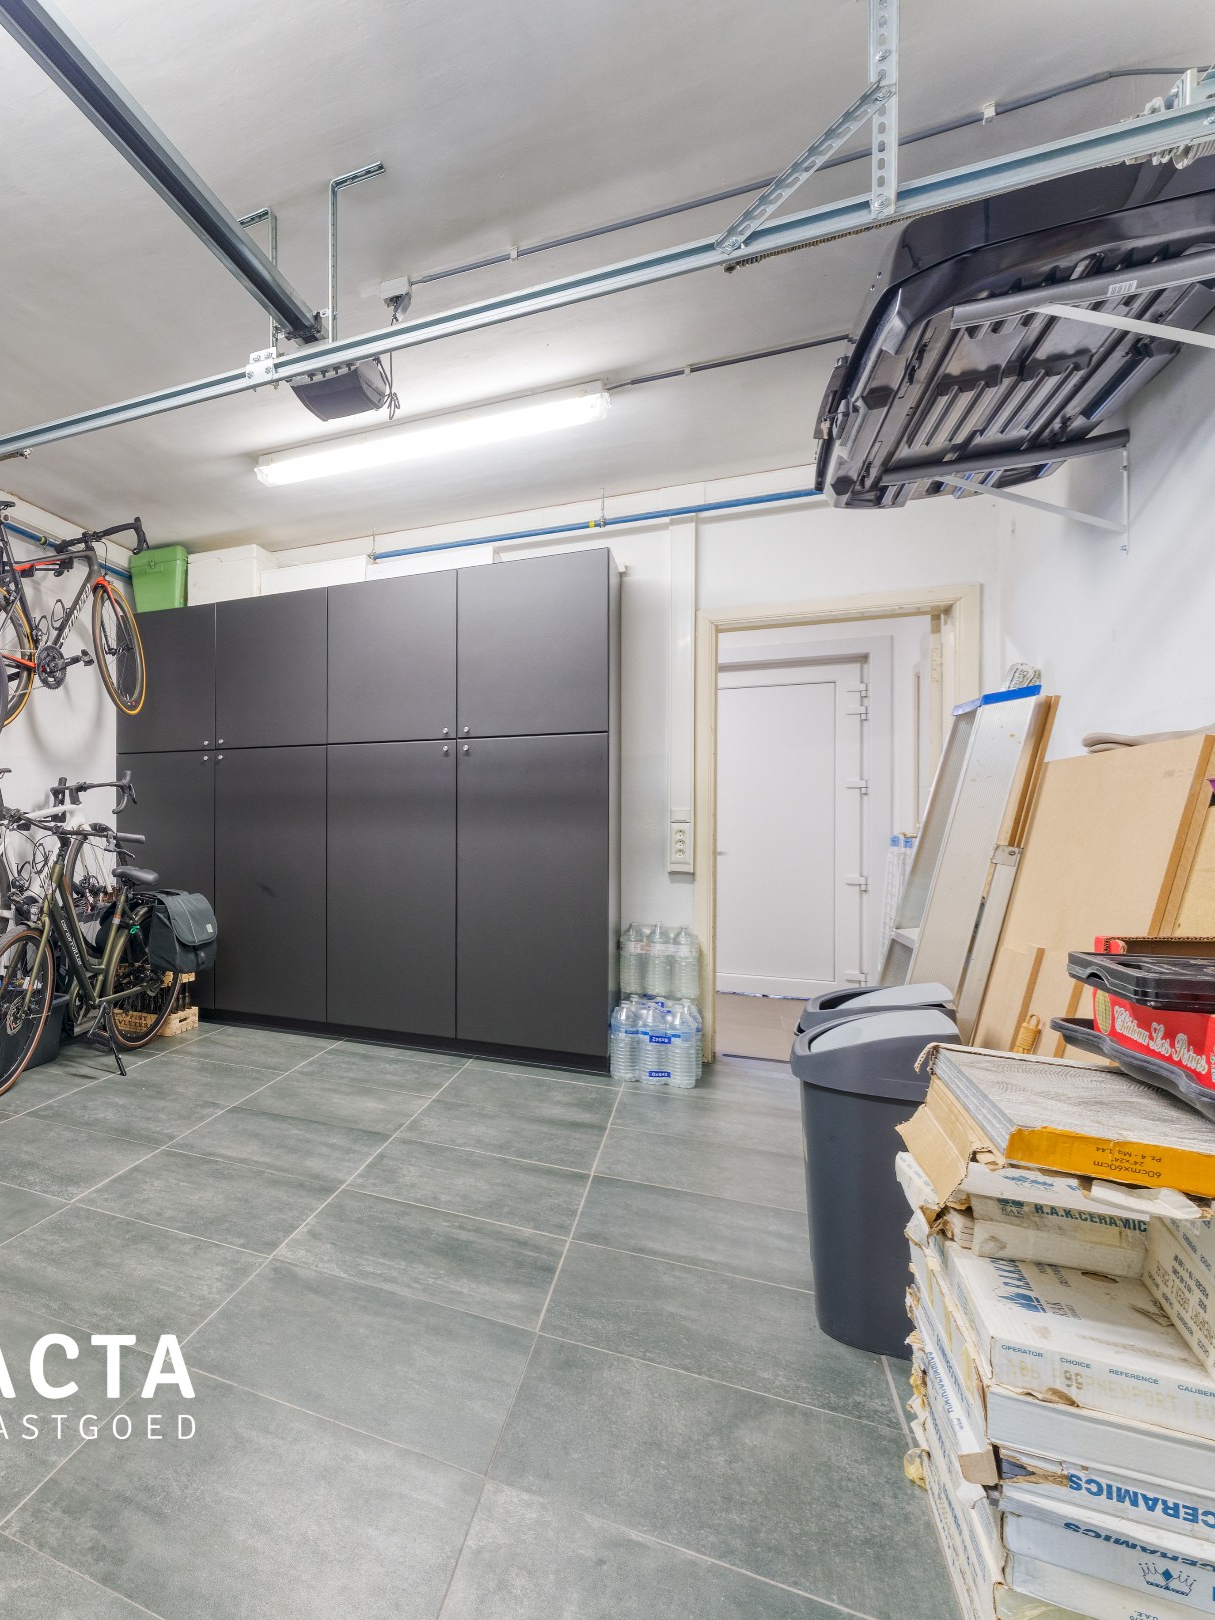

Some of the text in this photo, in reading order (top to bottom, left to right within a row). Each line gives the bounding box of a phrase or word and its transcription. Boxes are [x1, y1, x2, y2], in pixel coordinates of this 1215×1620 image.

[1093, 1160, 1162, 1178] 60cmx60cm
[1001, 1344, 1043, 1358] OPERATOR
[1059, 1357, 1091, 1369] CHOICE
[1108, 1368, 1159, 1385] REFERENCE
[1068, 1472, 1215, 1529] CERAMICS
[1063, 1522, 1215, 1572] CERAMICS
